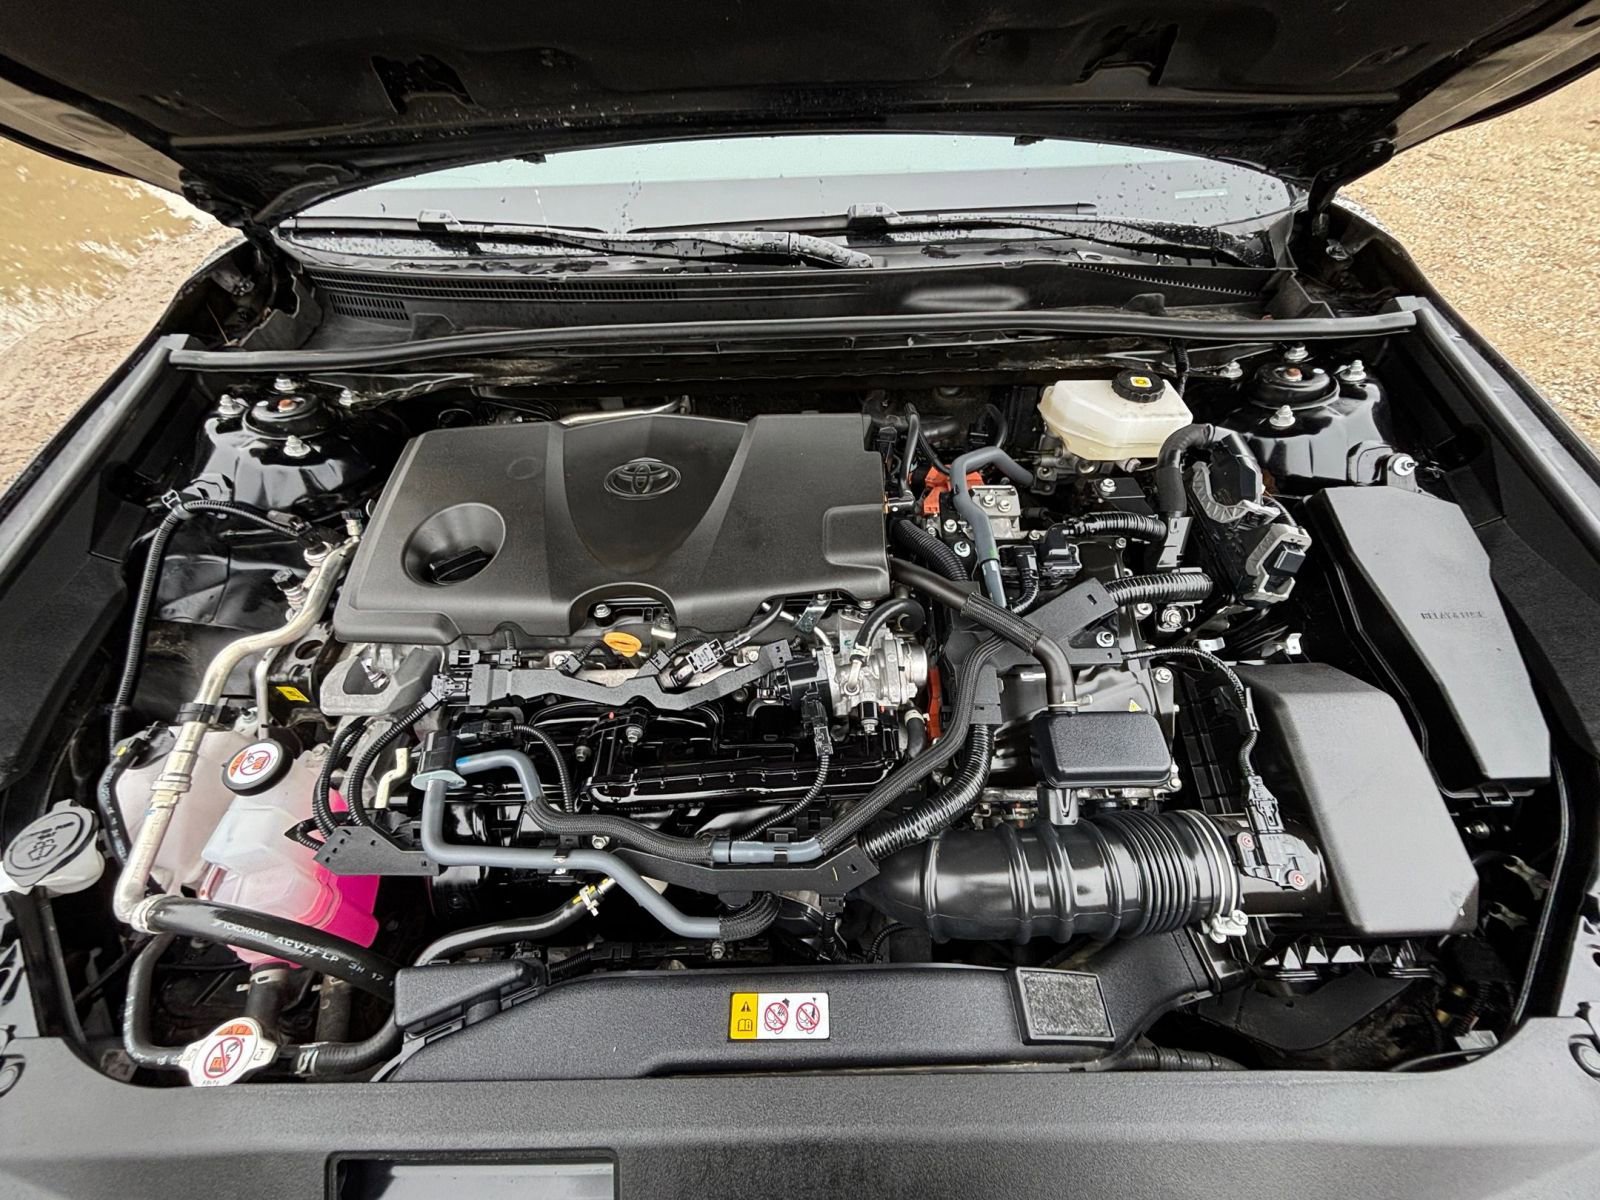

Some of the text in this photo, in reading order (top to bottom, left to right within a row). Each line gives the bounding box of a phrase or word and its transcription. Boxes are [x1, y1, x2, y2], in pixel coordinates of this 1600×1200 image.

[223, 922, 269, 940] YOKOHAMA
[274, 936, 318, 955] ACV17
[321, 952, 339, 963] LP
